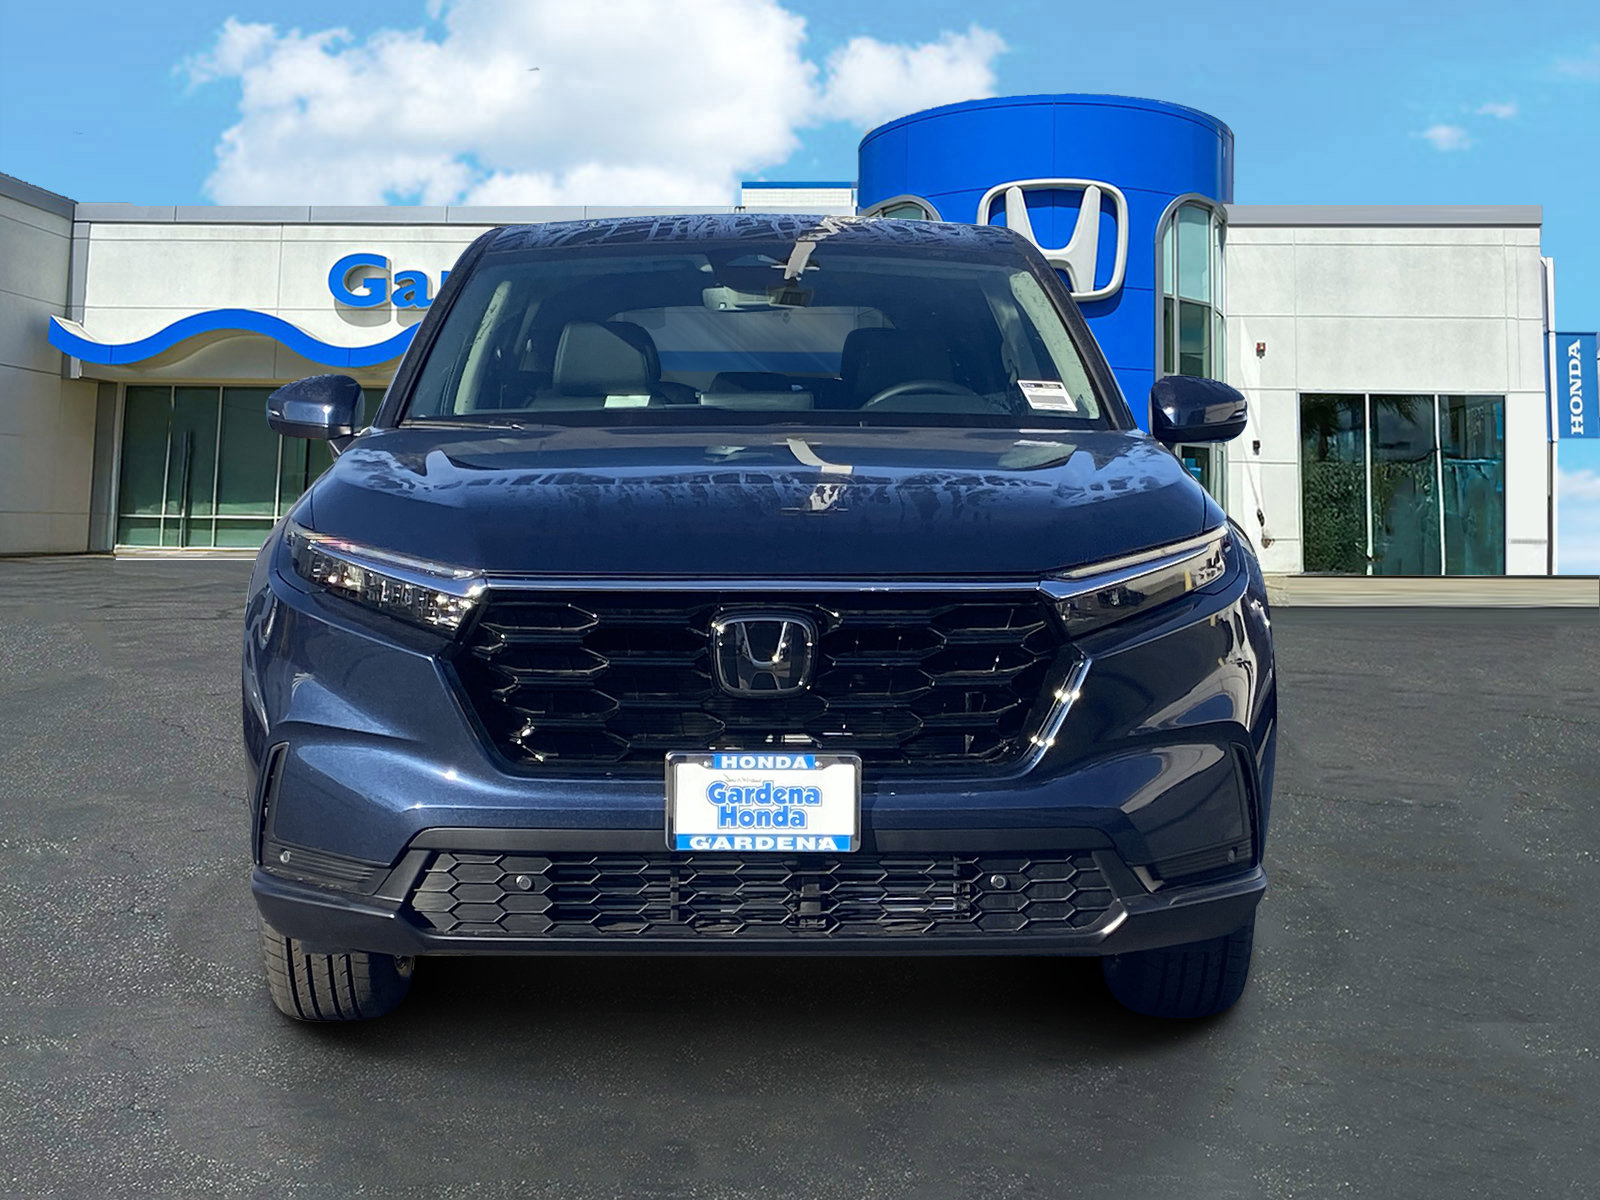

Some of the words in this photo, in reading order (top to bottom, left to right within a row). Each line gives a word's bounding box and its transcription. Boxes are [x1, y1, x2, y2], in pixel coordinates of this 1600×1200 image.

[1568, 339, 1584, 435] HONDA
[721, 756, 809, 769] HONDA
[707, 782, 822, 806] Gardena
[718, 804, 807, 828] Honda
[689, 836, 839, 850] GARDENA
